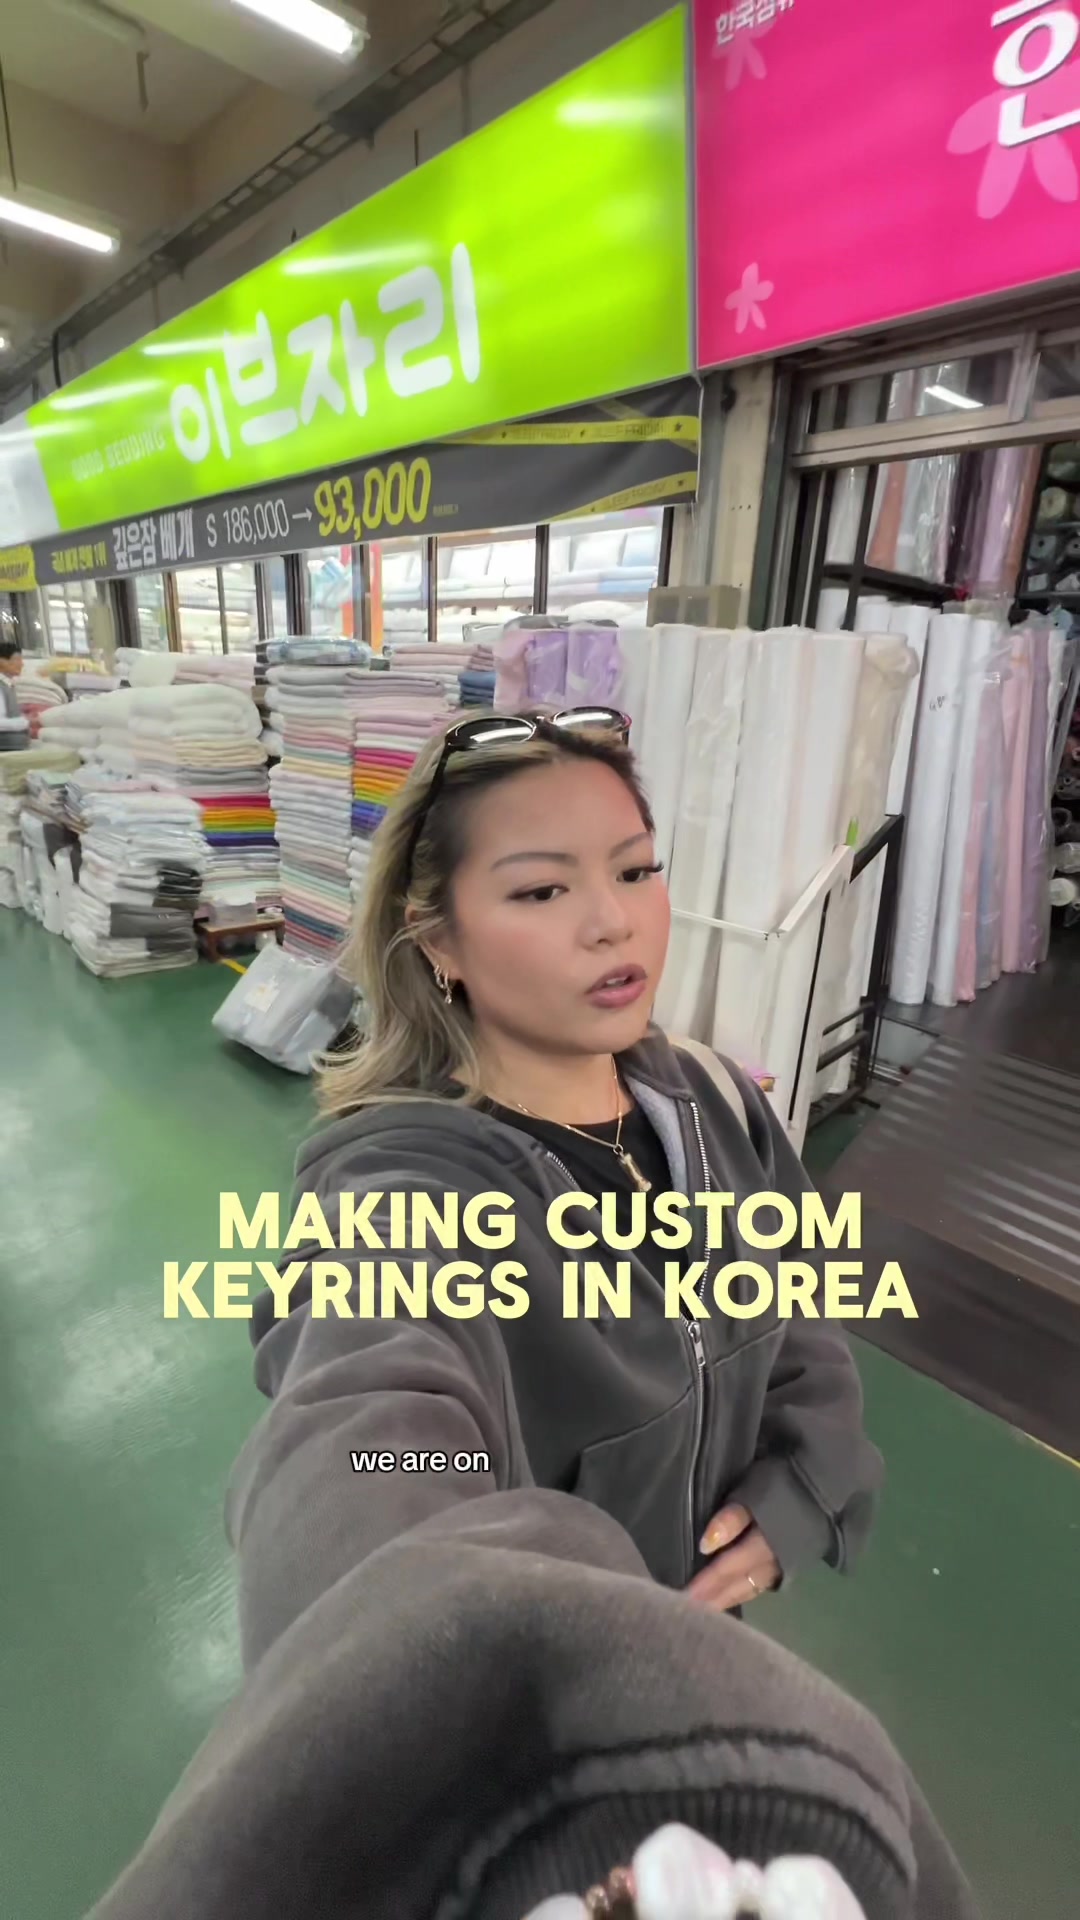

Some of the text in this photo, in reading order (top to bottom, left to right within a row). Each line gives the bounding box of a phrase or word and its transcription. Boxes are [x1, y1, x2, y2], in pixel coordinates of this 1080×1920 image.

[169, 242, 481, 464] 이브자리
[112, 516, 157, 571] 깊은잠
[160, 507, 195, 560] 베개
[206, 512, 218, 548] S
[223, 499, 290, 545] 186,000
[314, 457, 432, 540] 93,000
